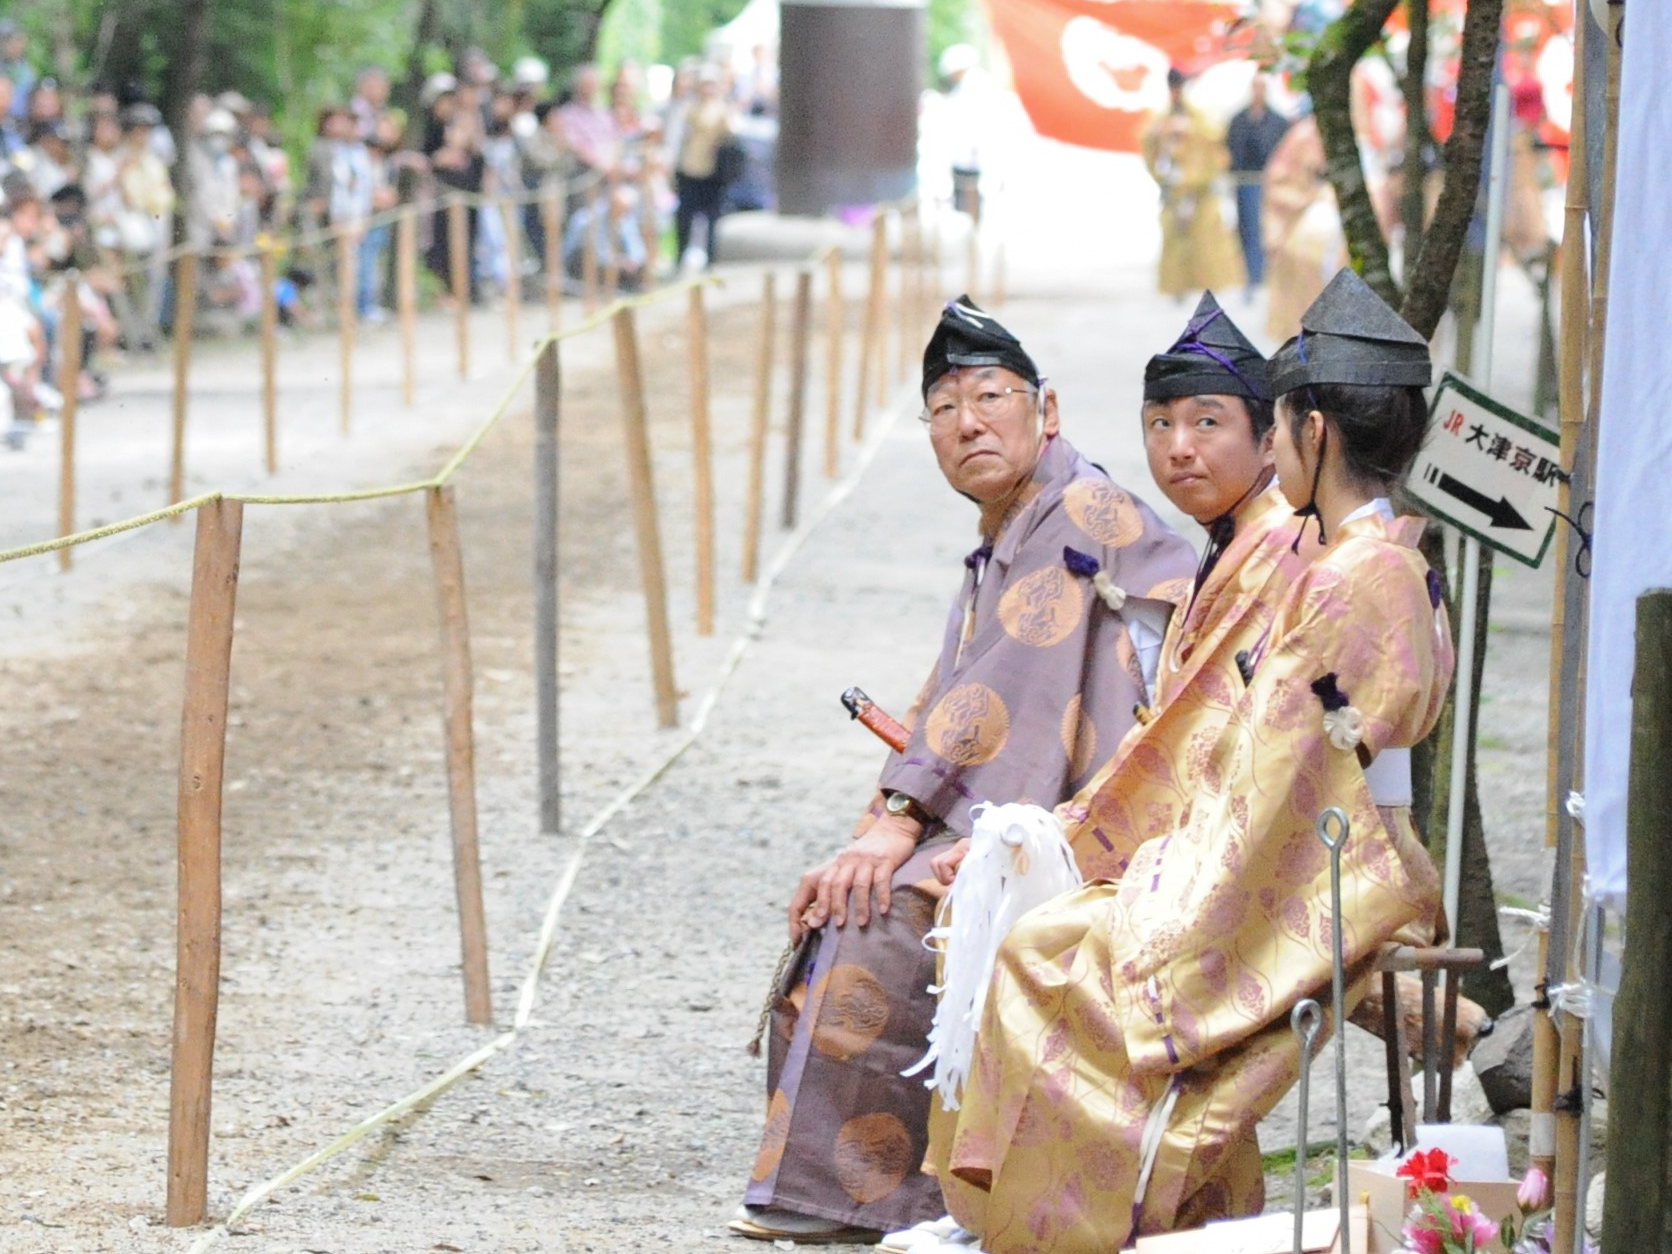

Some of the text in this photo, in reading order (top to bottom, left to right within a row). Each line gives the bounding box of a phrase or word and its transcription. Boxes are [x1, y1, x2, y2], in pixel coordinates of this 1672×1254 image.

[1443, 409, 1560, 488] JR 大津京駅
